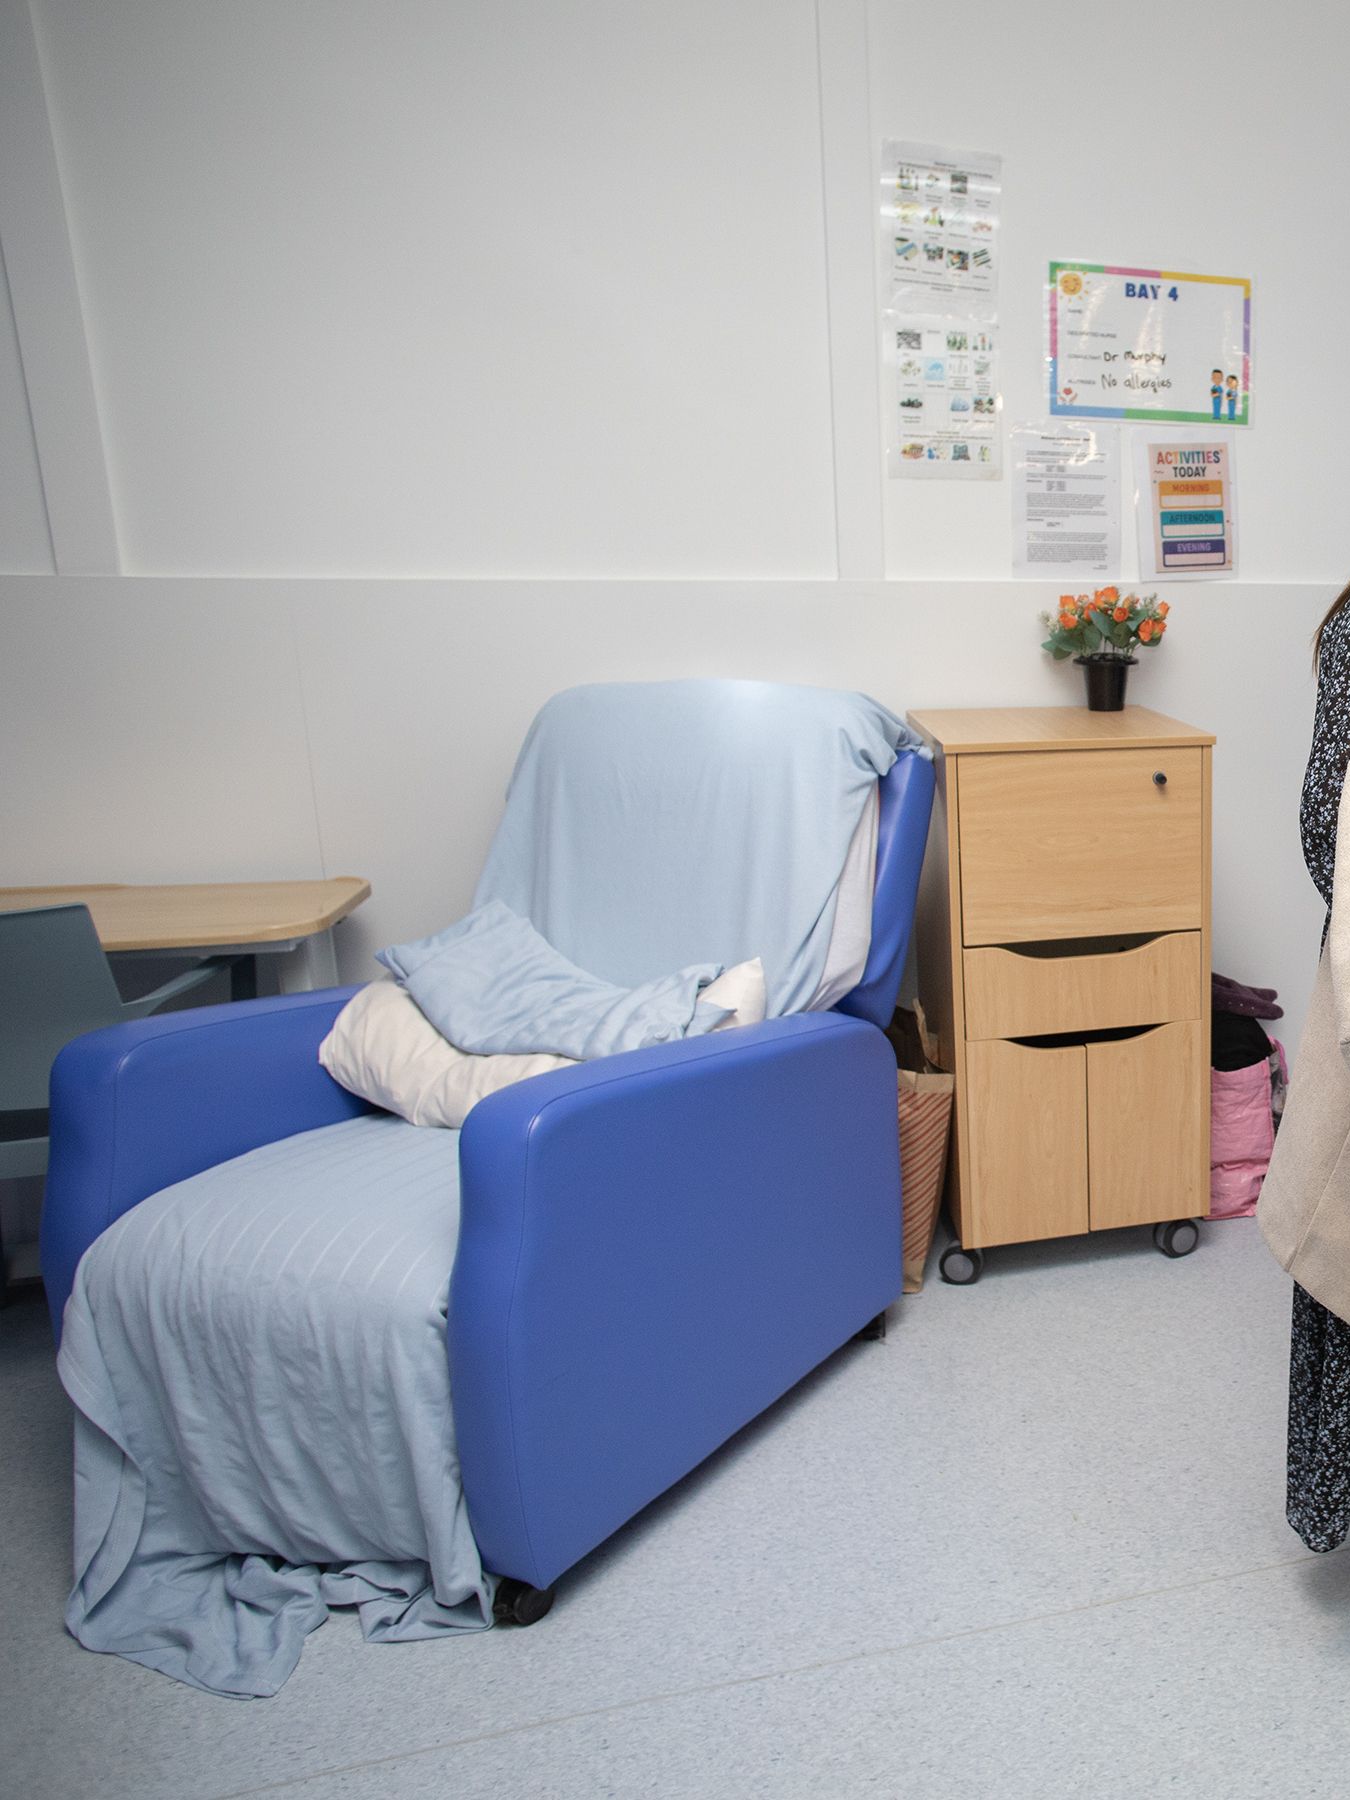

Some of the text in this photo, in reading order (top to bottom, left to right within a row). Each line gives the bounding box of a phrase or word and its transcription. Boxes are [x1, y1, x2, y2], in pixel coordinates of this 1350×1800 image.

[1125, 282, 1178, 301] BAY 4
[1103, 351, 1119, 362] Dr
[1124, 351, 1166, 365] Murphy
[1101, 373, 1172, 393] No allergies
[1157, 450, 1220, 465] ACTIVITIES
[1172, 466, 1206, 478] TODAY
[1172, 483, 1210, 493] MORNING
[1169, 513, 1216, 522] AFTERNOON
[1177, 542, 1211, 552] EVENING
